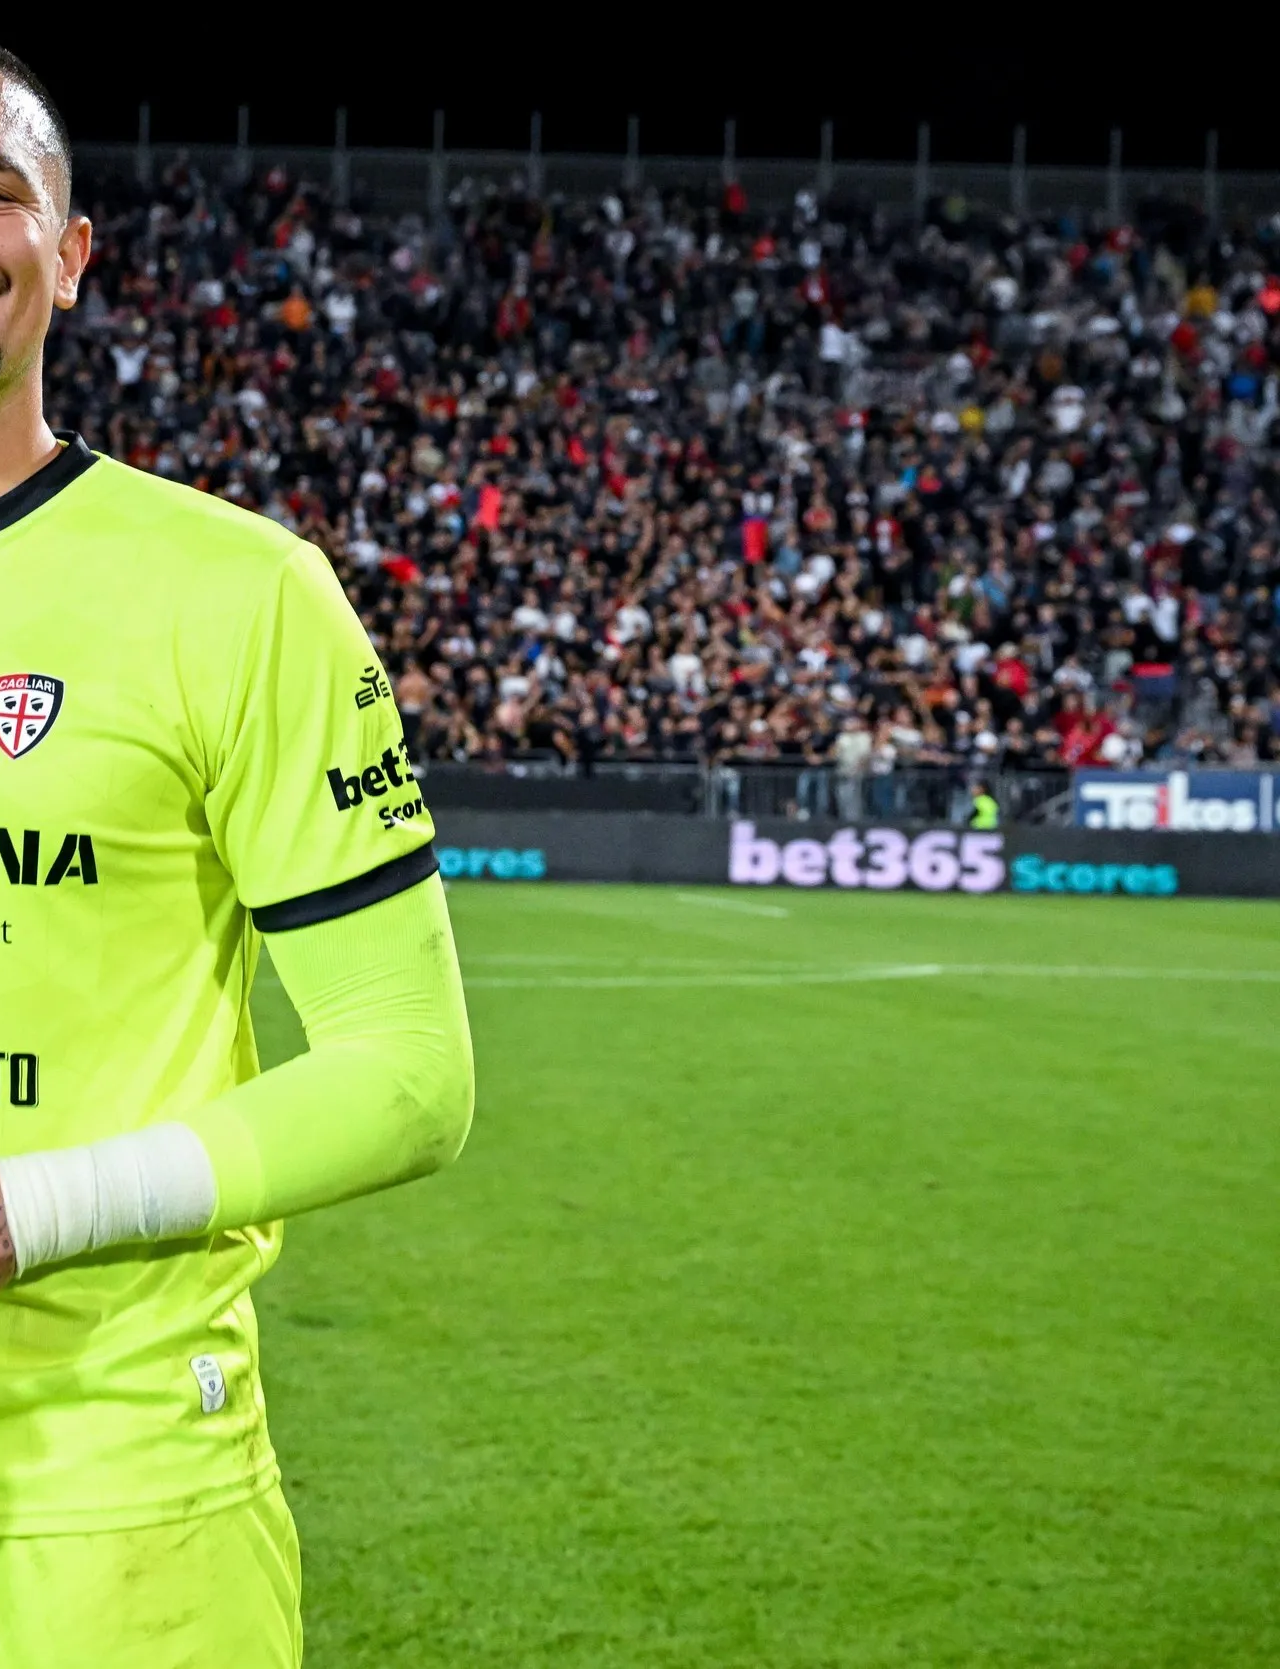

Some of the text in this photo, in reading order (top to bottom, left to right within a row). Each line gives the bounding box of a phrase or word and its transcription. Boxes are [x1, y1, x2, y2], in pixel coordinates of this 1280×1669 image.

[0, 677, 56, 694] CAGLIARI
[729, 819, 1178, 893] bet365 Scores
